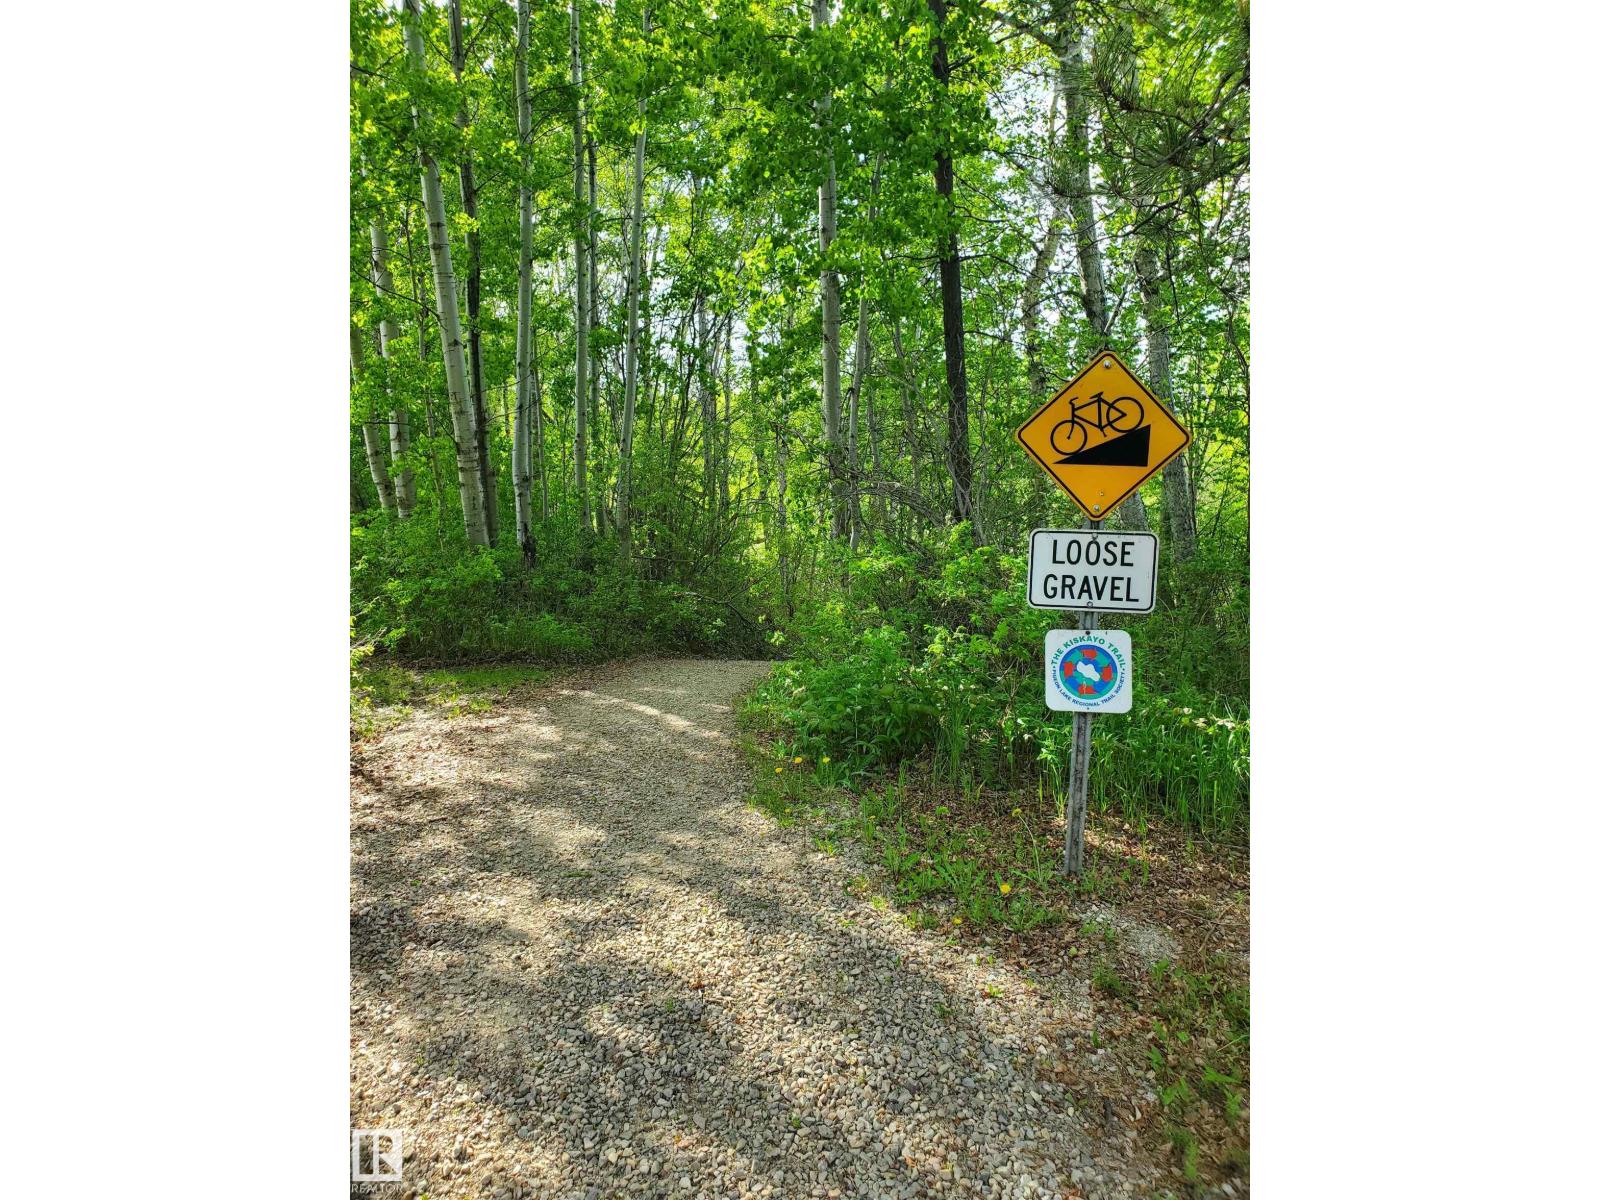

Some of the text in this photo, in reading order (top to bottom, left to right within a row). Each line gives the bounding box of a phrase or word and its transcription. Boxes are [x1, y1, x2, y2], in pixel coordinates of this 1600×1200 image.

[1052, 539, 1135, 567] LOOSE
[1043, 573, 1139, 602] GRAVEL
[1051, 635, 1126, 668] THE KISKAYO TRAIL
[1059, 689, 1071, 702] LAKE
[1072, 698, 1100, 707] REGIONAL
[1101, 694, 1116, 704] TRAIL
